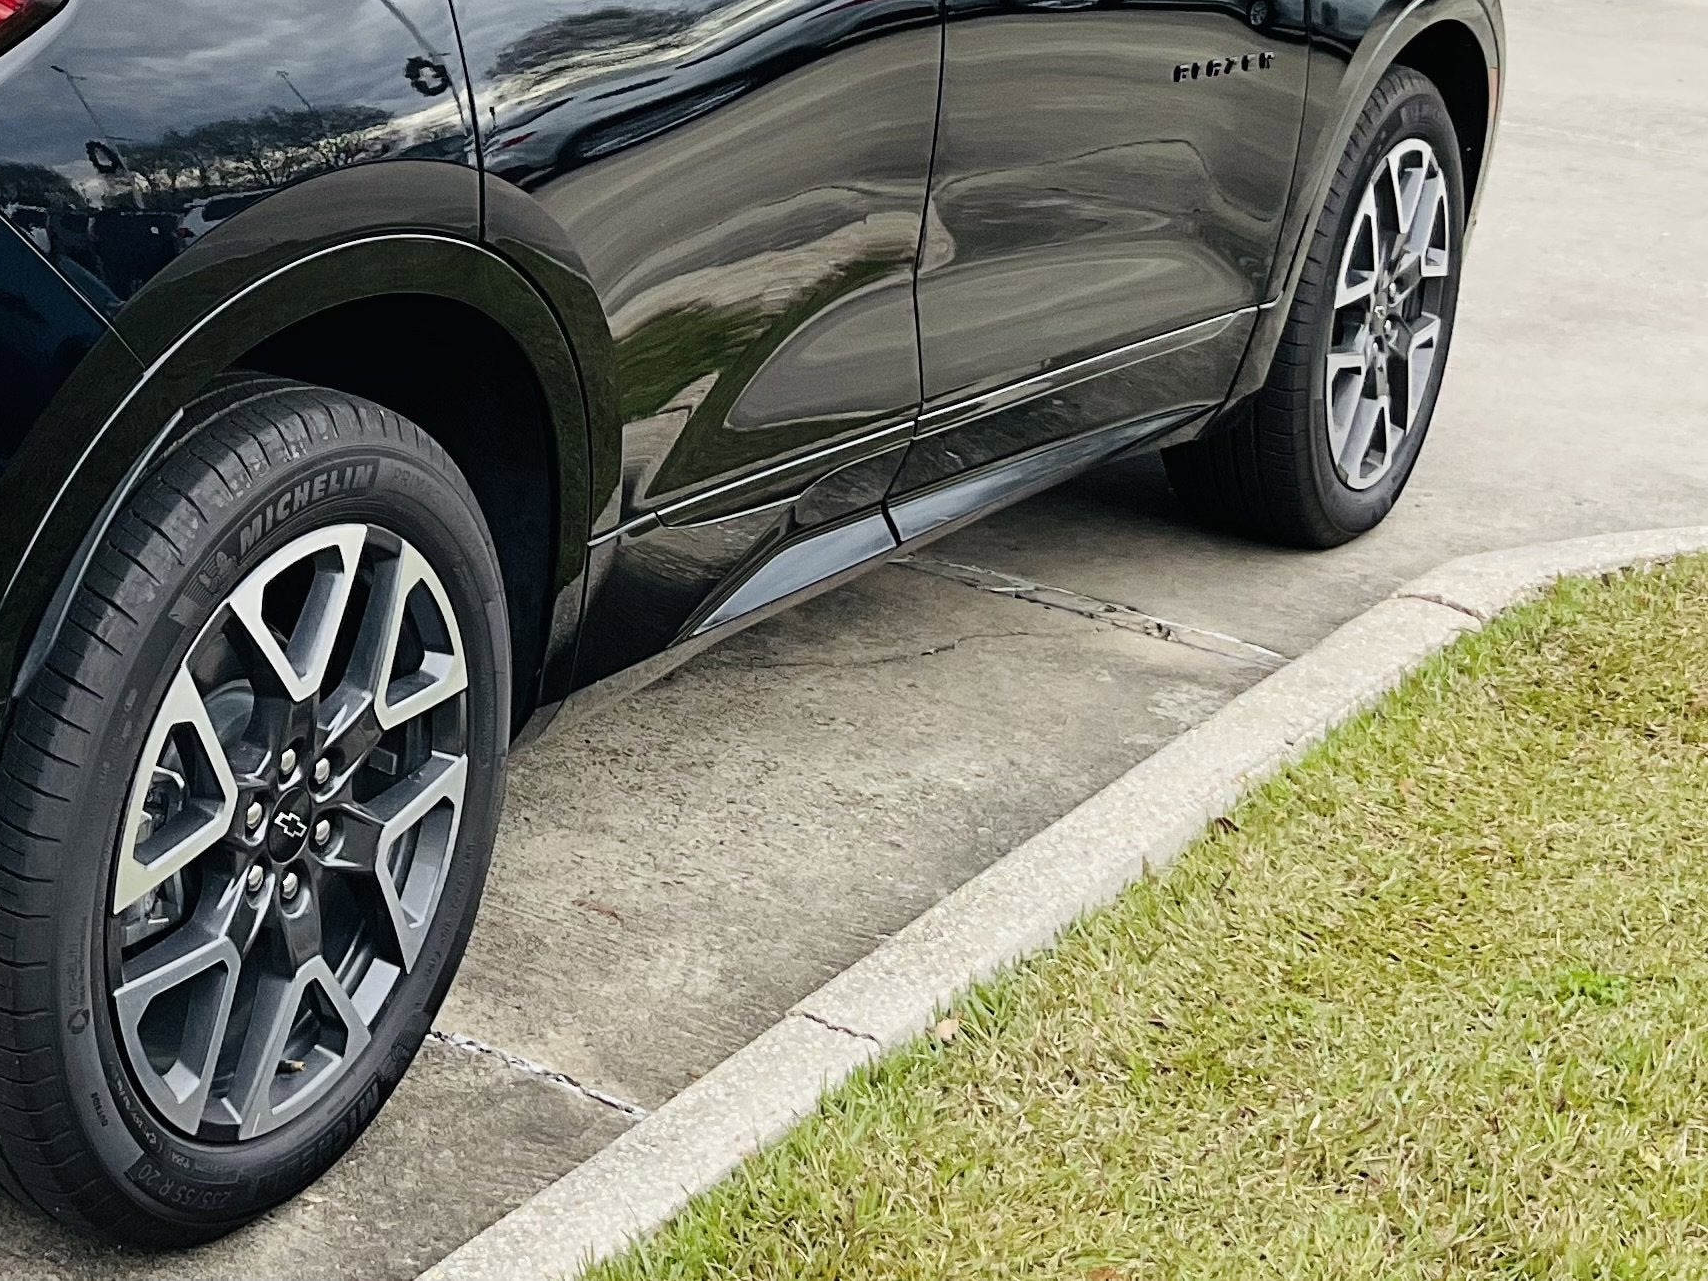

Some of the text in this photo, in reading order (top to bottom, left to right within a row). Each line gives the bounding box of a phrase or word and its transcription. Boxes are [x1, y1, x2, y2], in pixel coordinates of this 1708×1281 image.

[239, 463, 374, 555] MICHELIN
[138, 1163, 161, 1187] 20
[159, 1180, 171, 1197] R
